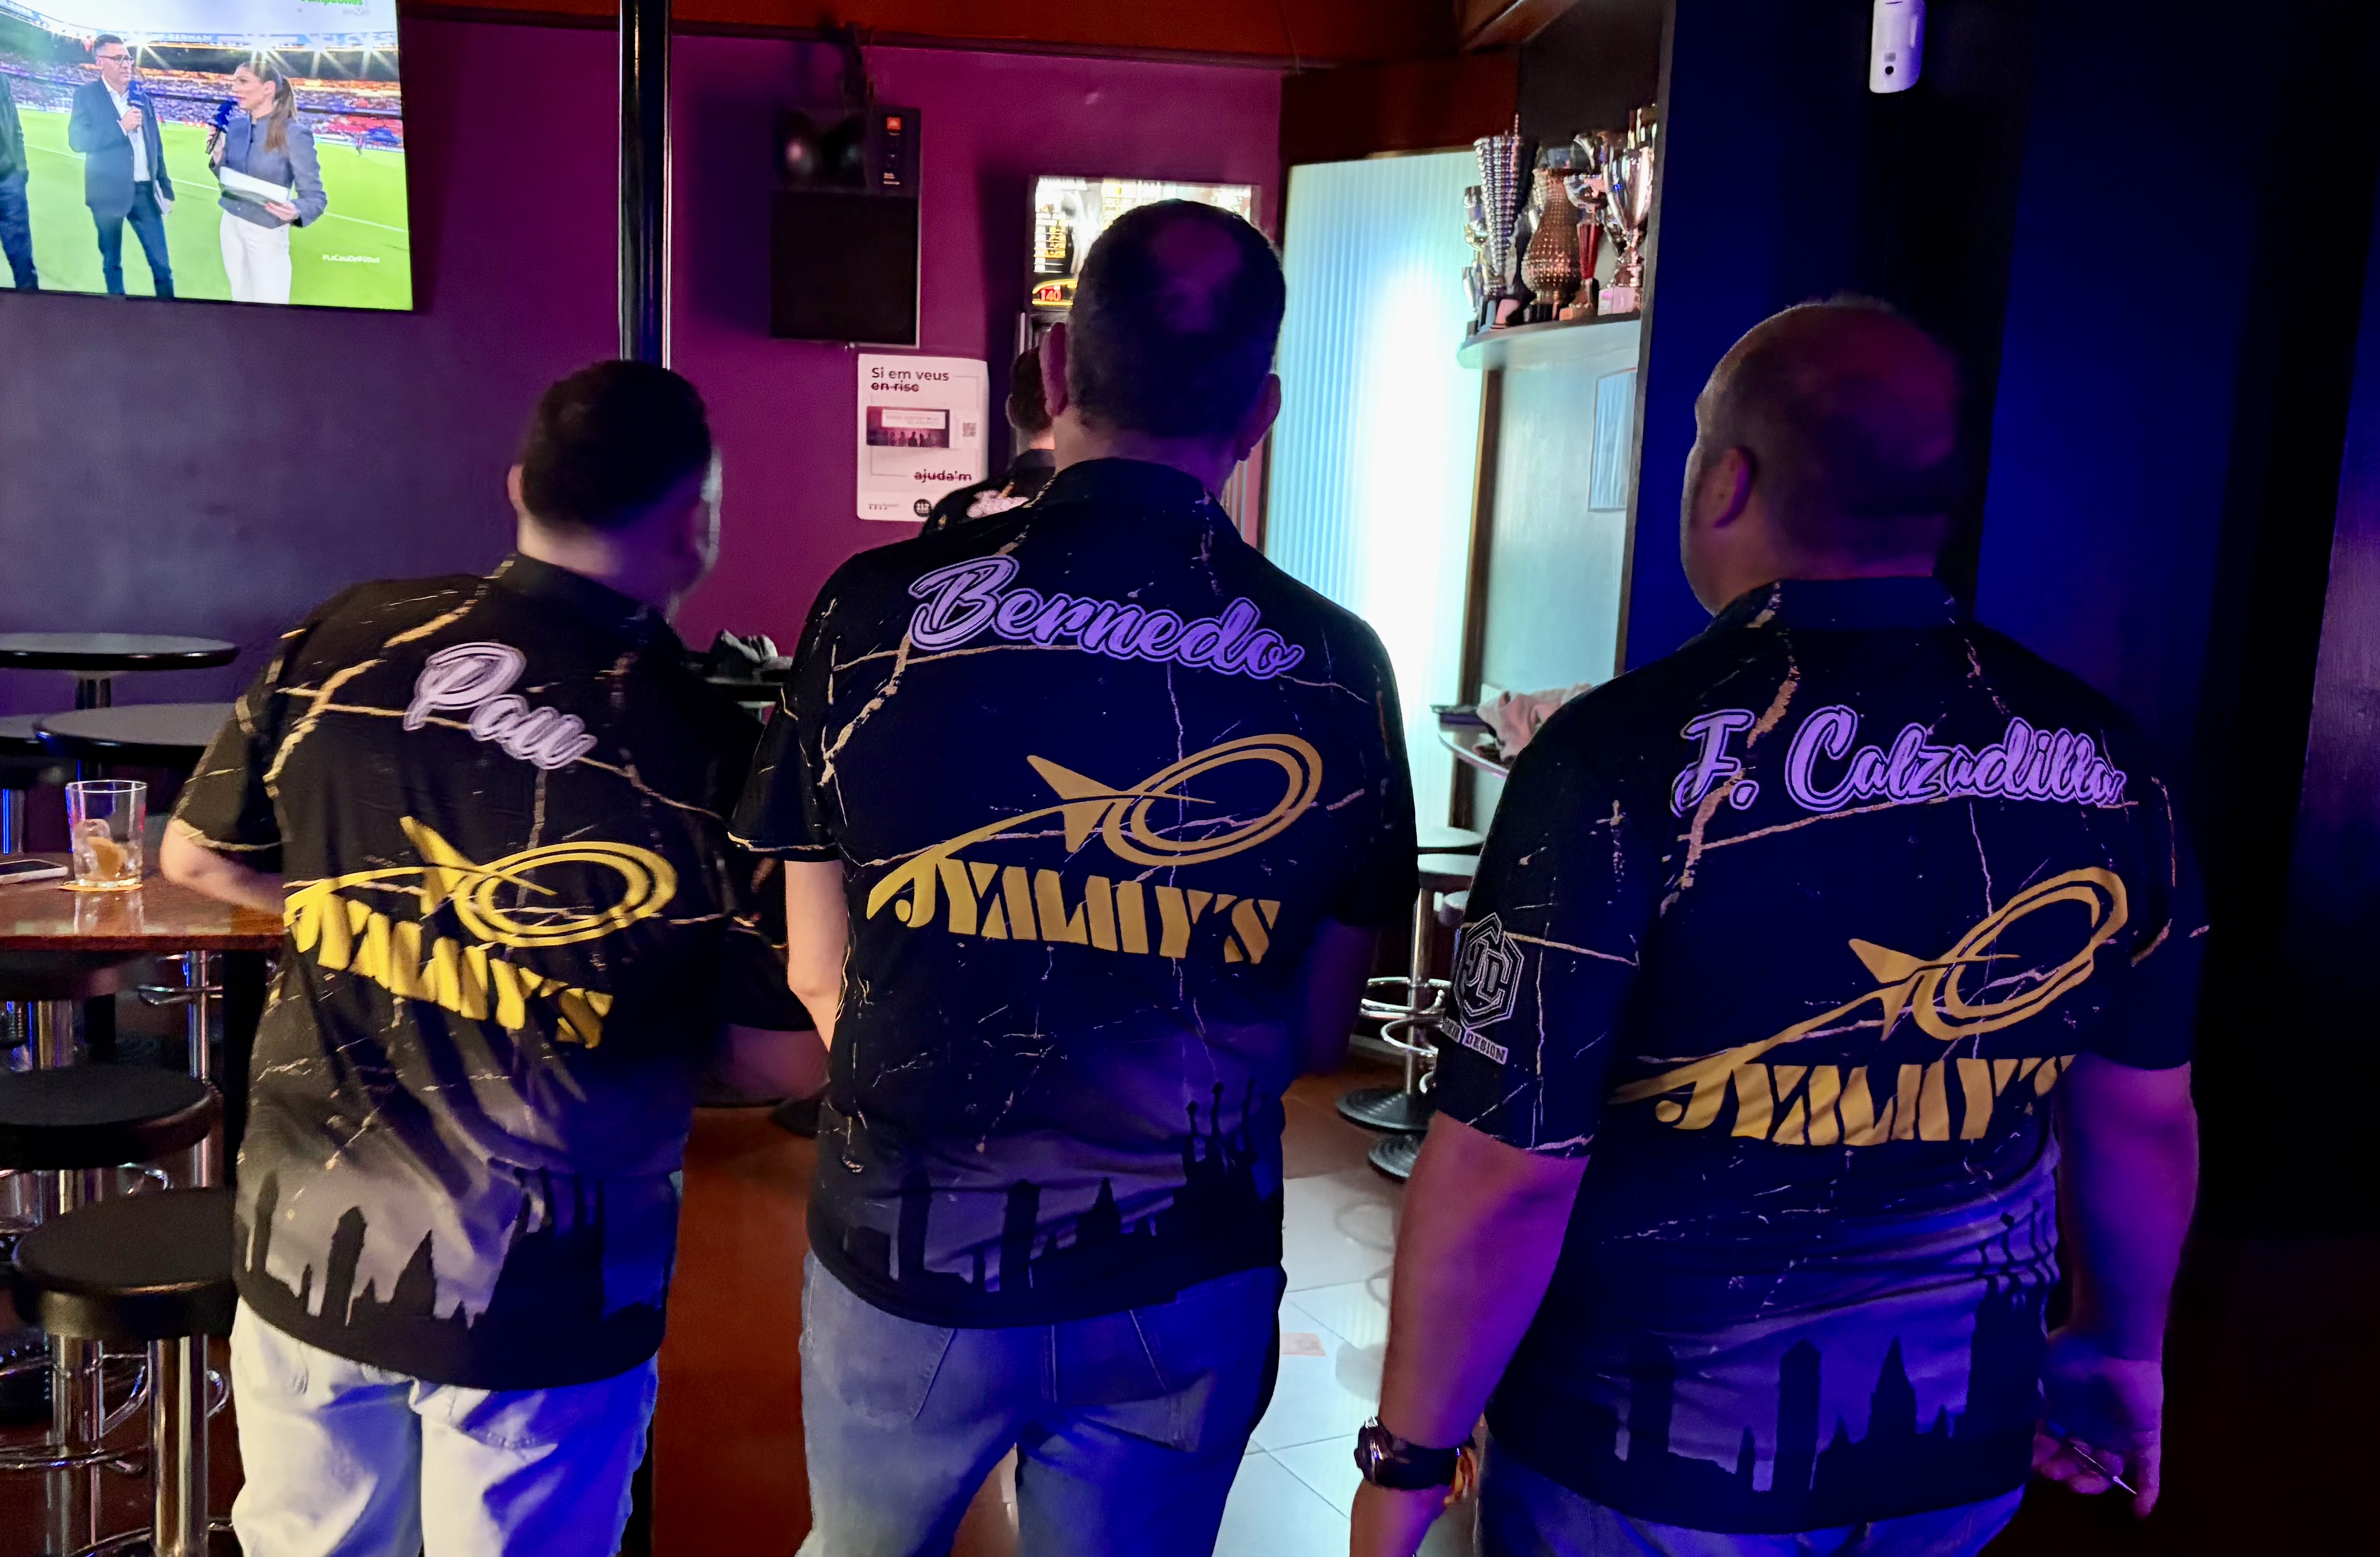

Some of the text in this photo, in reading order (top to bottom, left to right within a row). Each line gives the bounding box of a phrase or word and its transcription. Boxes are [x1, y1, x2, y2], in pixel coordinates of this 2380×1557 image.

[871, 367, 949, 381] Si em veus
[909, 555, 1305, 680] Bernedo
[1670, 704, 2127, 817] F. Calzadilla
